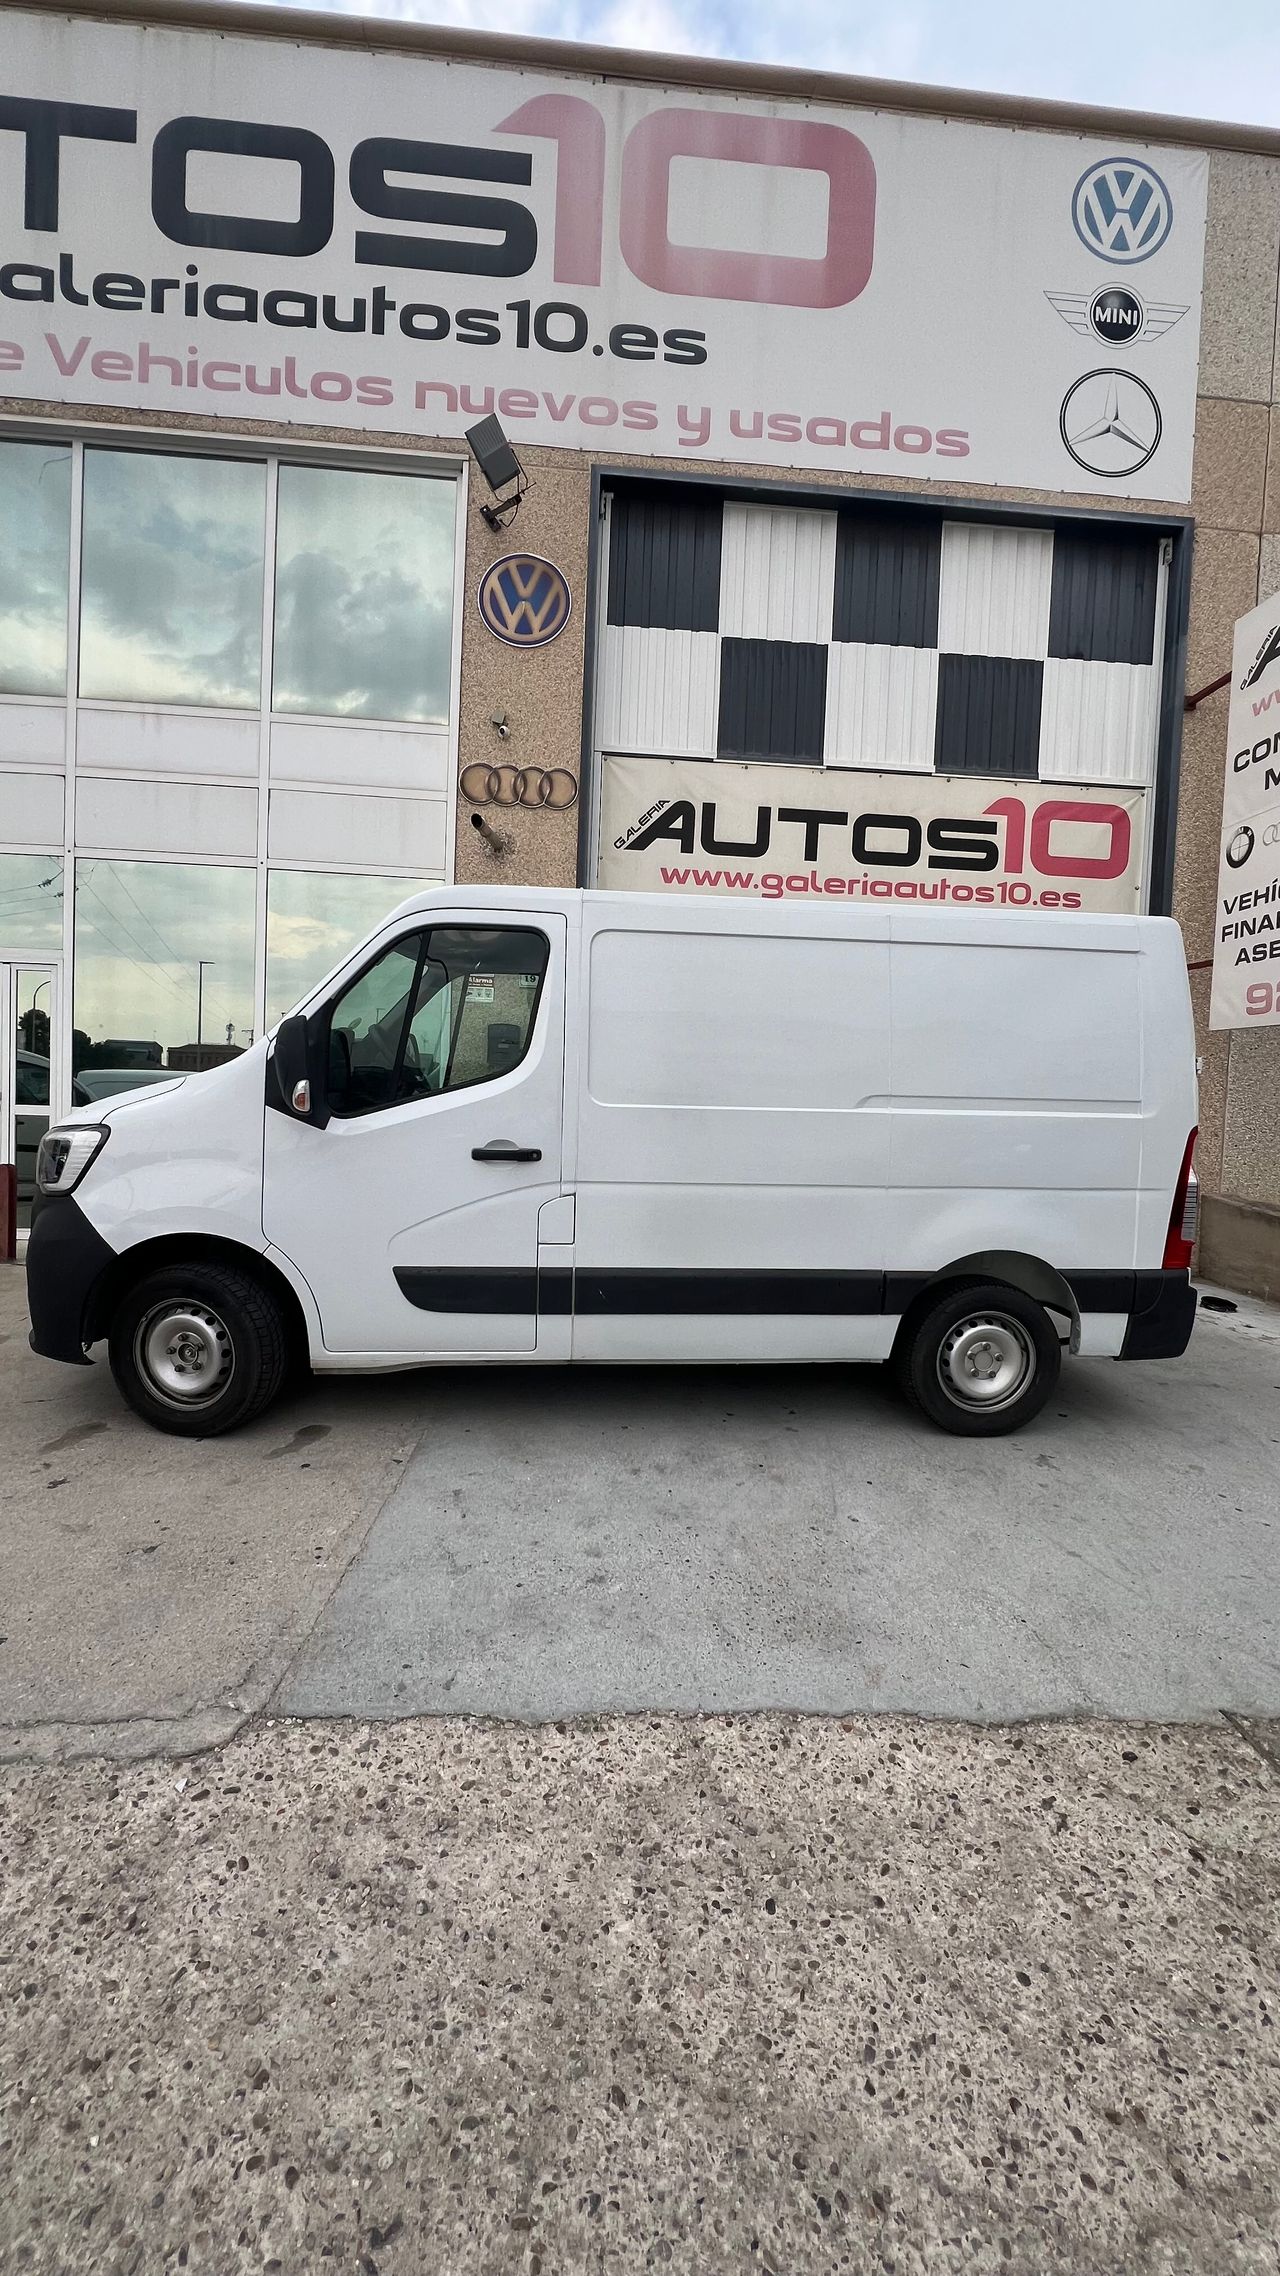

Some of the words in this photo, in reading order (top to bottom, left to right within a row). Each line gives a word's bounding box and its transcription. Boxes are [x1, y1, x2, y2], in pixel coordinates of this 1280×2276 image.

[1096, 306, 1138, 326] MINI
[44, 333, 393, 406] Vehiculos
[415, 380, 658, 431] nuevos
[677, 405, 711, 447] y
[730, 411, 969, 457] usados
[1252, 690, 1280, 717] w
[613, 800, 671, 850] GALERIA
[623, 796, 1132, 881] AUTOS10
[659, 867, 1082, 910] www.galeriaautos10.es
[1223, 878, 1280, 915] VEHÍ
[1221, 911, 1280, 943] FINA
[1246, 979, 1280, 1017] 9
